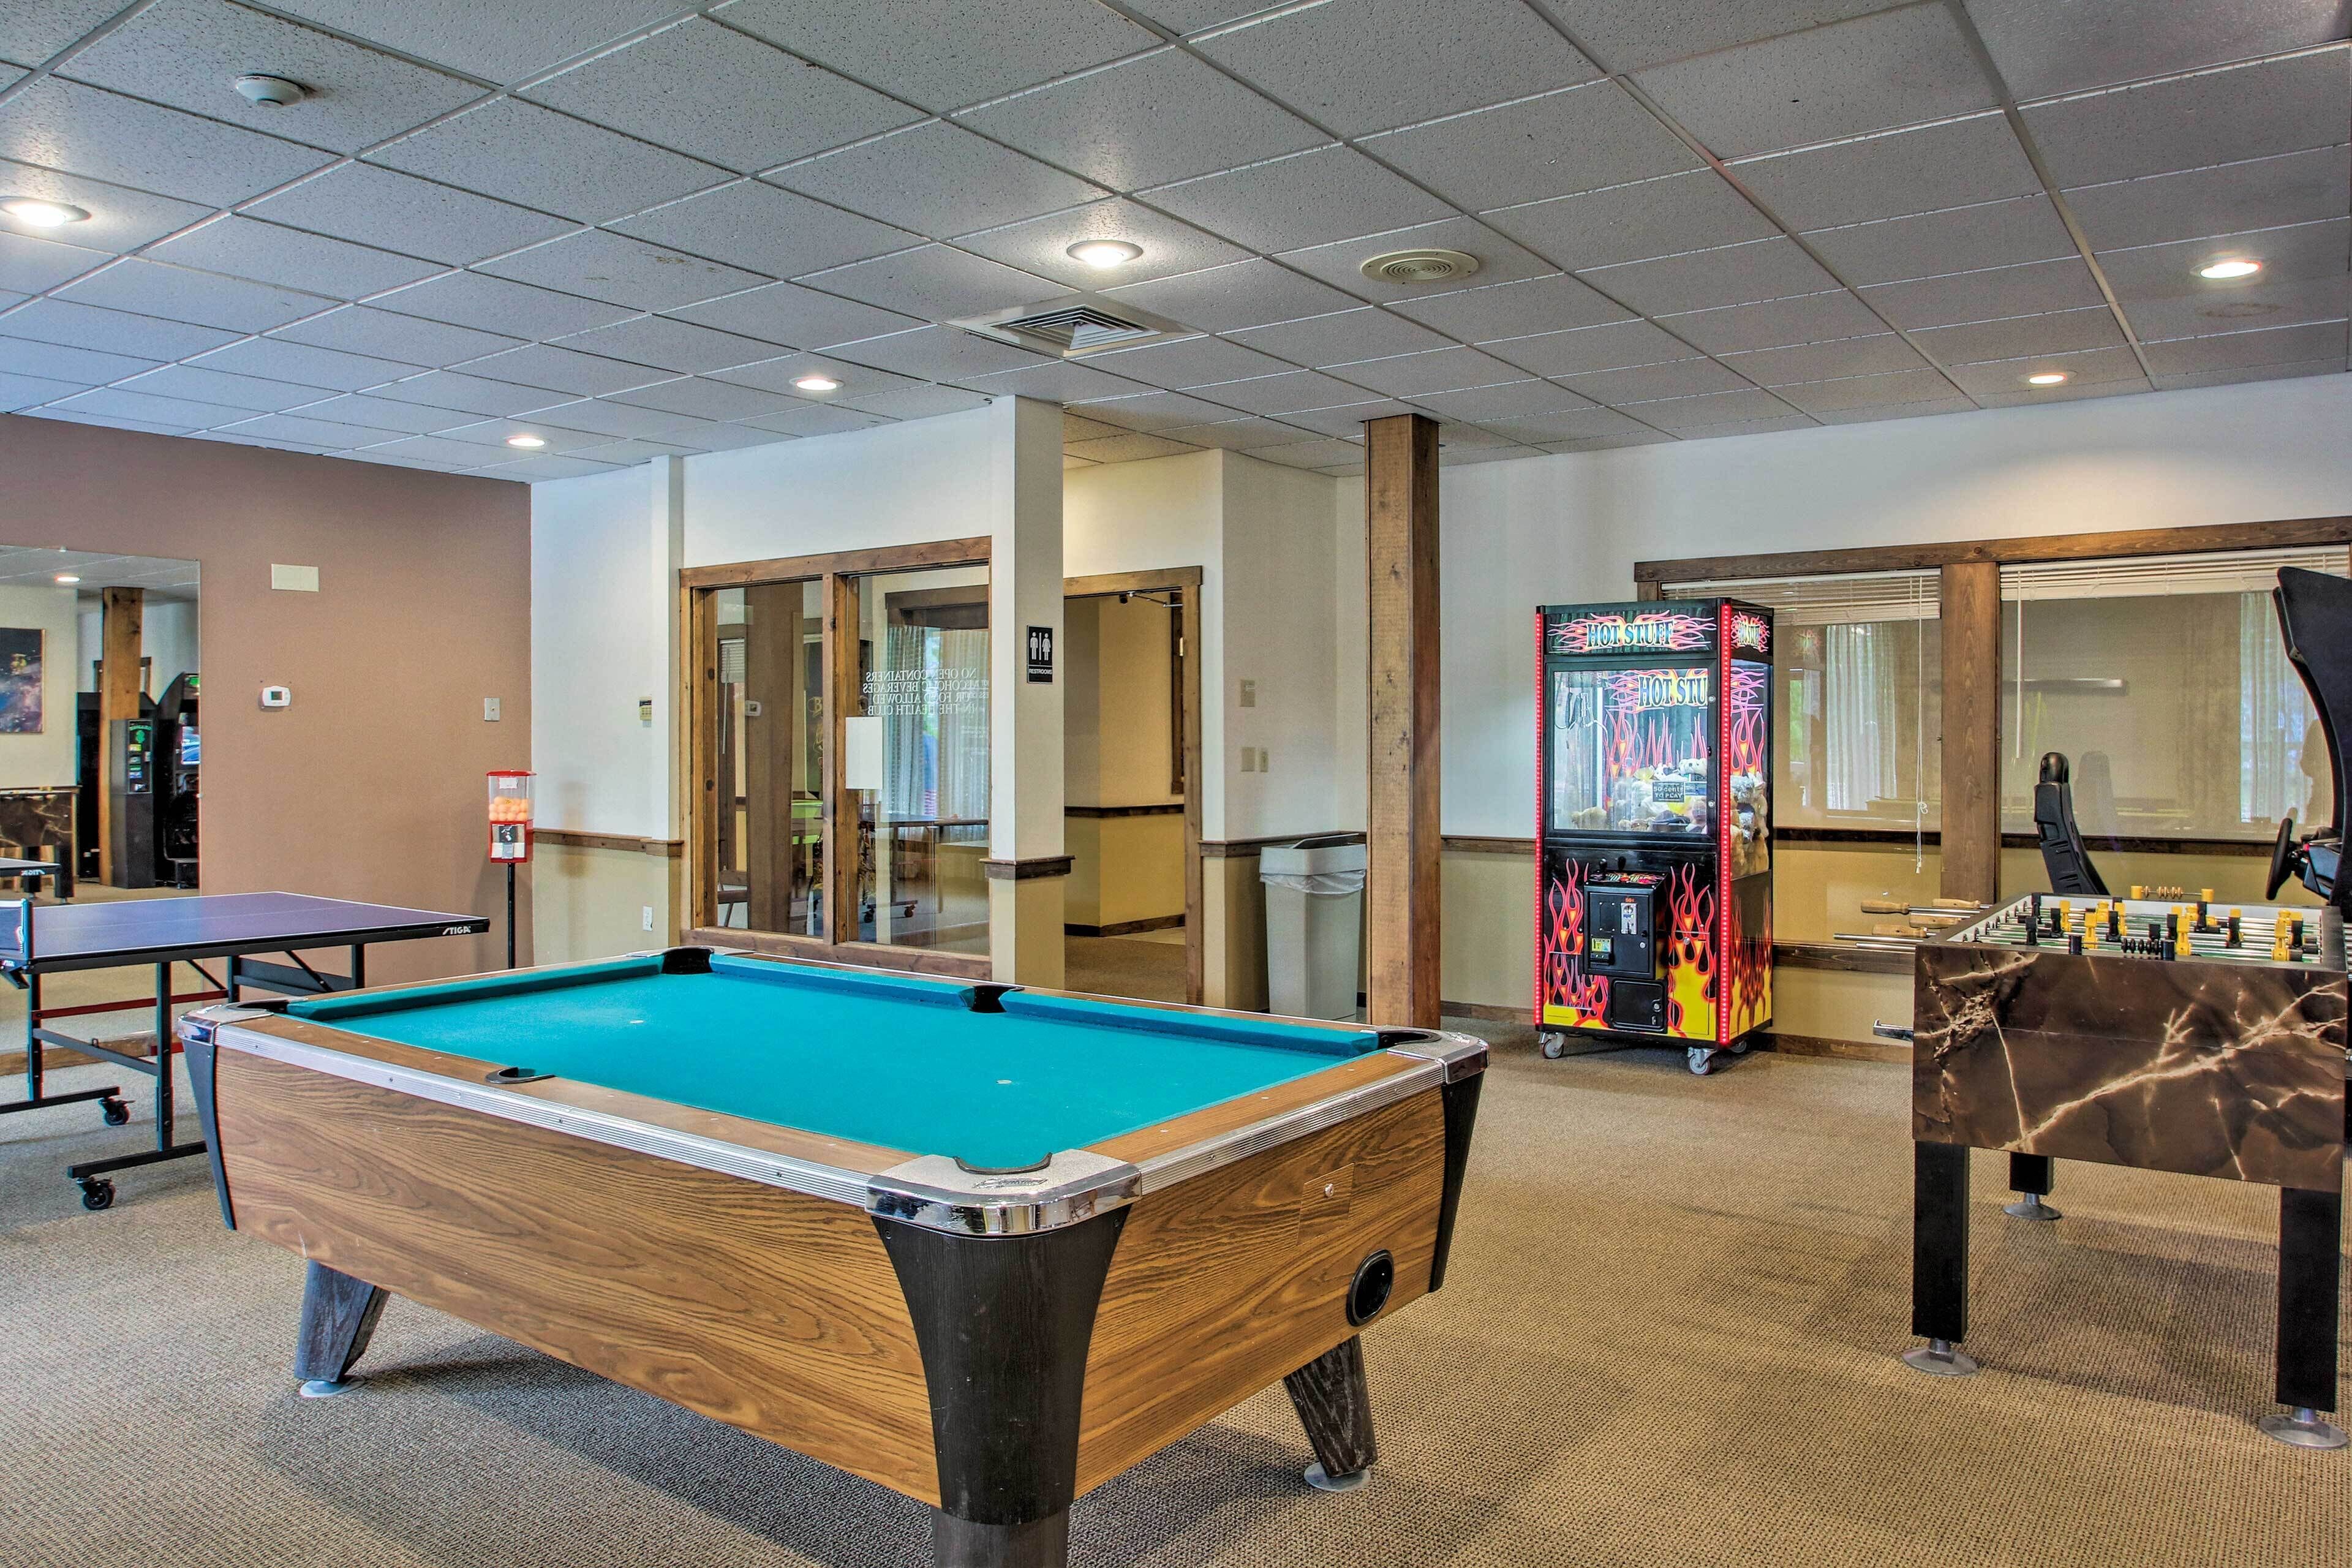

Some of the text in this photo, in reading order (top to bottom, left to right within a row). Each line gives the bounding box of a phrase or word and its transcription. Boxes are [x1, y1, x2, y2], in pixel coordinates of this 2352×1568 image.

[1587, 620, 1674, 647] HOT STUFF
[1638, 676, 1672, 706] HOT
[442, 925, 471, 935] STIGA
